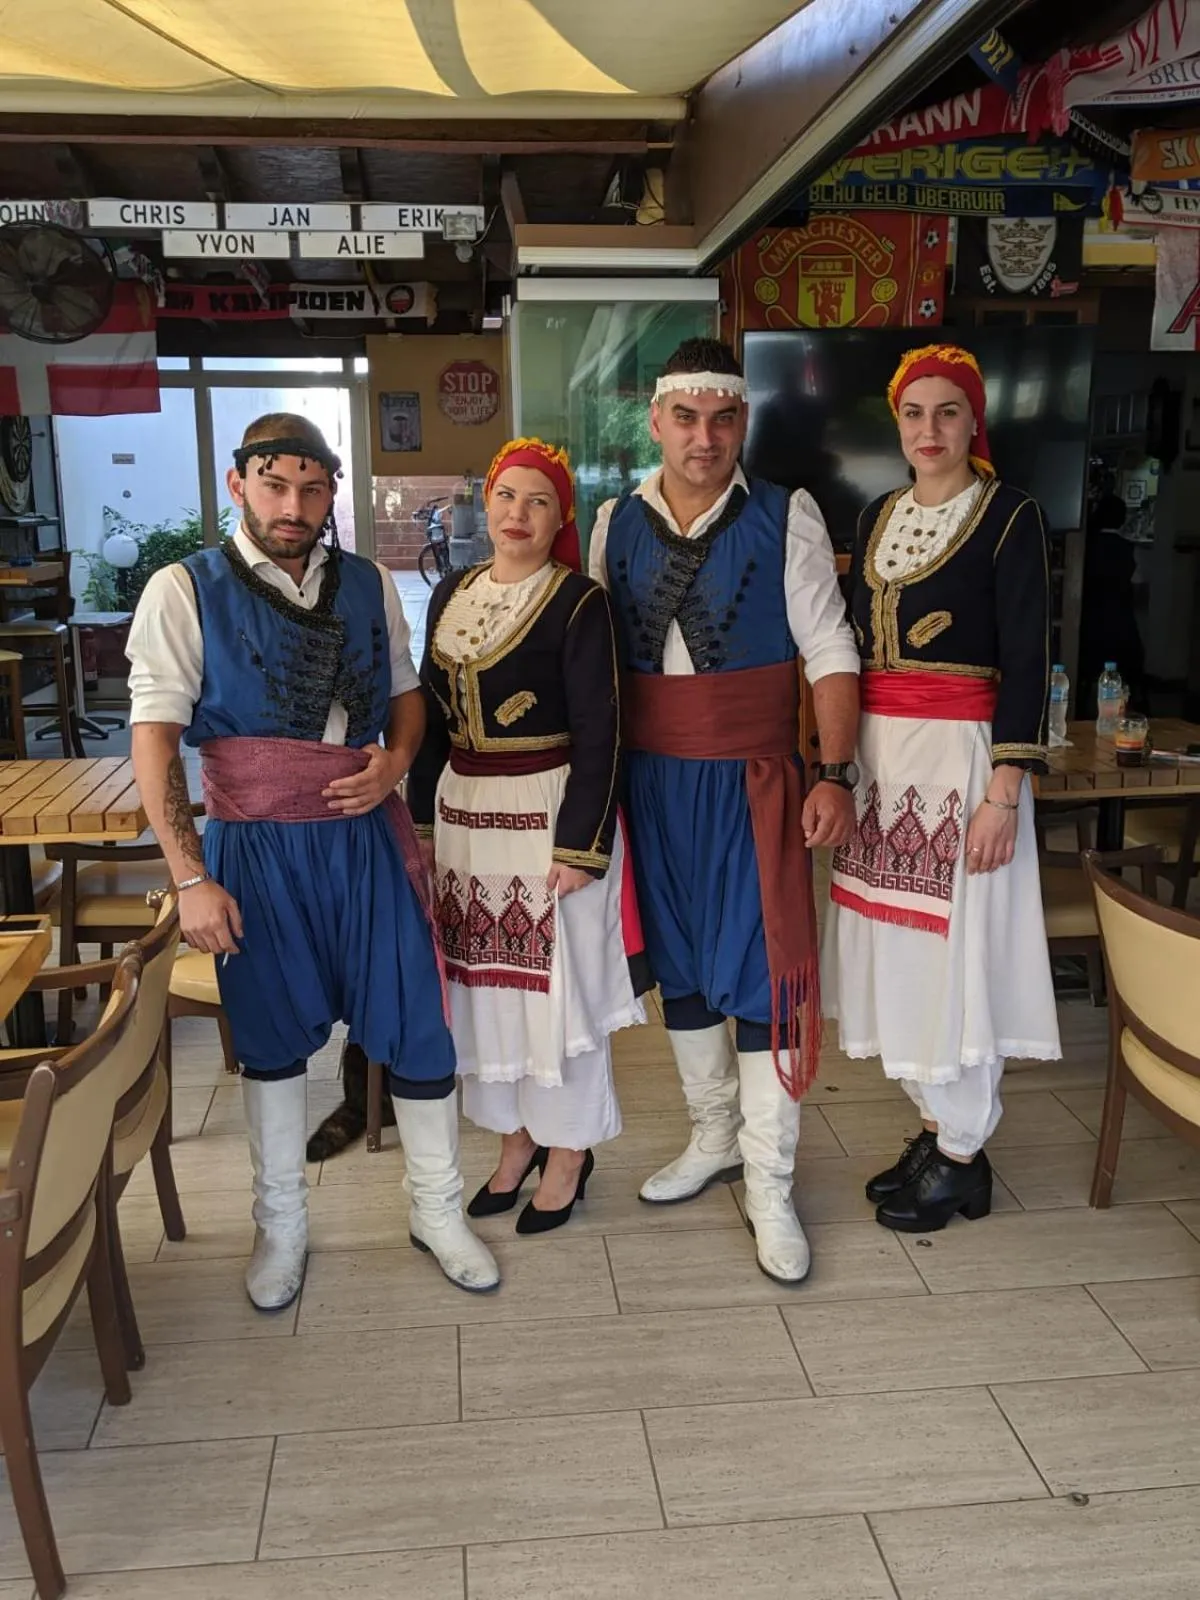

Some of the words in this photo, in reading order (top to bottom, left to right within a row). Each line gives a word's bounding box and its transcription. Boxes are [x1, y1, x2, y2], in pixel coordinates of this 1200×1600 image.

[818, 144, 1050, 186] VERIGE
[862, 183, 908, 204] GELB
[119, 204, 186, 225] CHRIS
[268, 207, 311, 227] JAN
[398, 208, 445, 228] ERIK
[197, 233, 255, 254] YVON
[337, 235, 386, 255] ALIE
[769, 222, 884, 269] MANCHESTER
[979, 264, 997, 294] Est.
[444, 372, 492, 392] STOP
